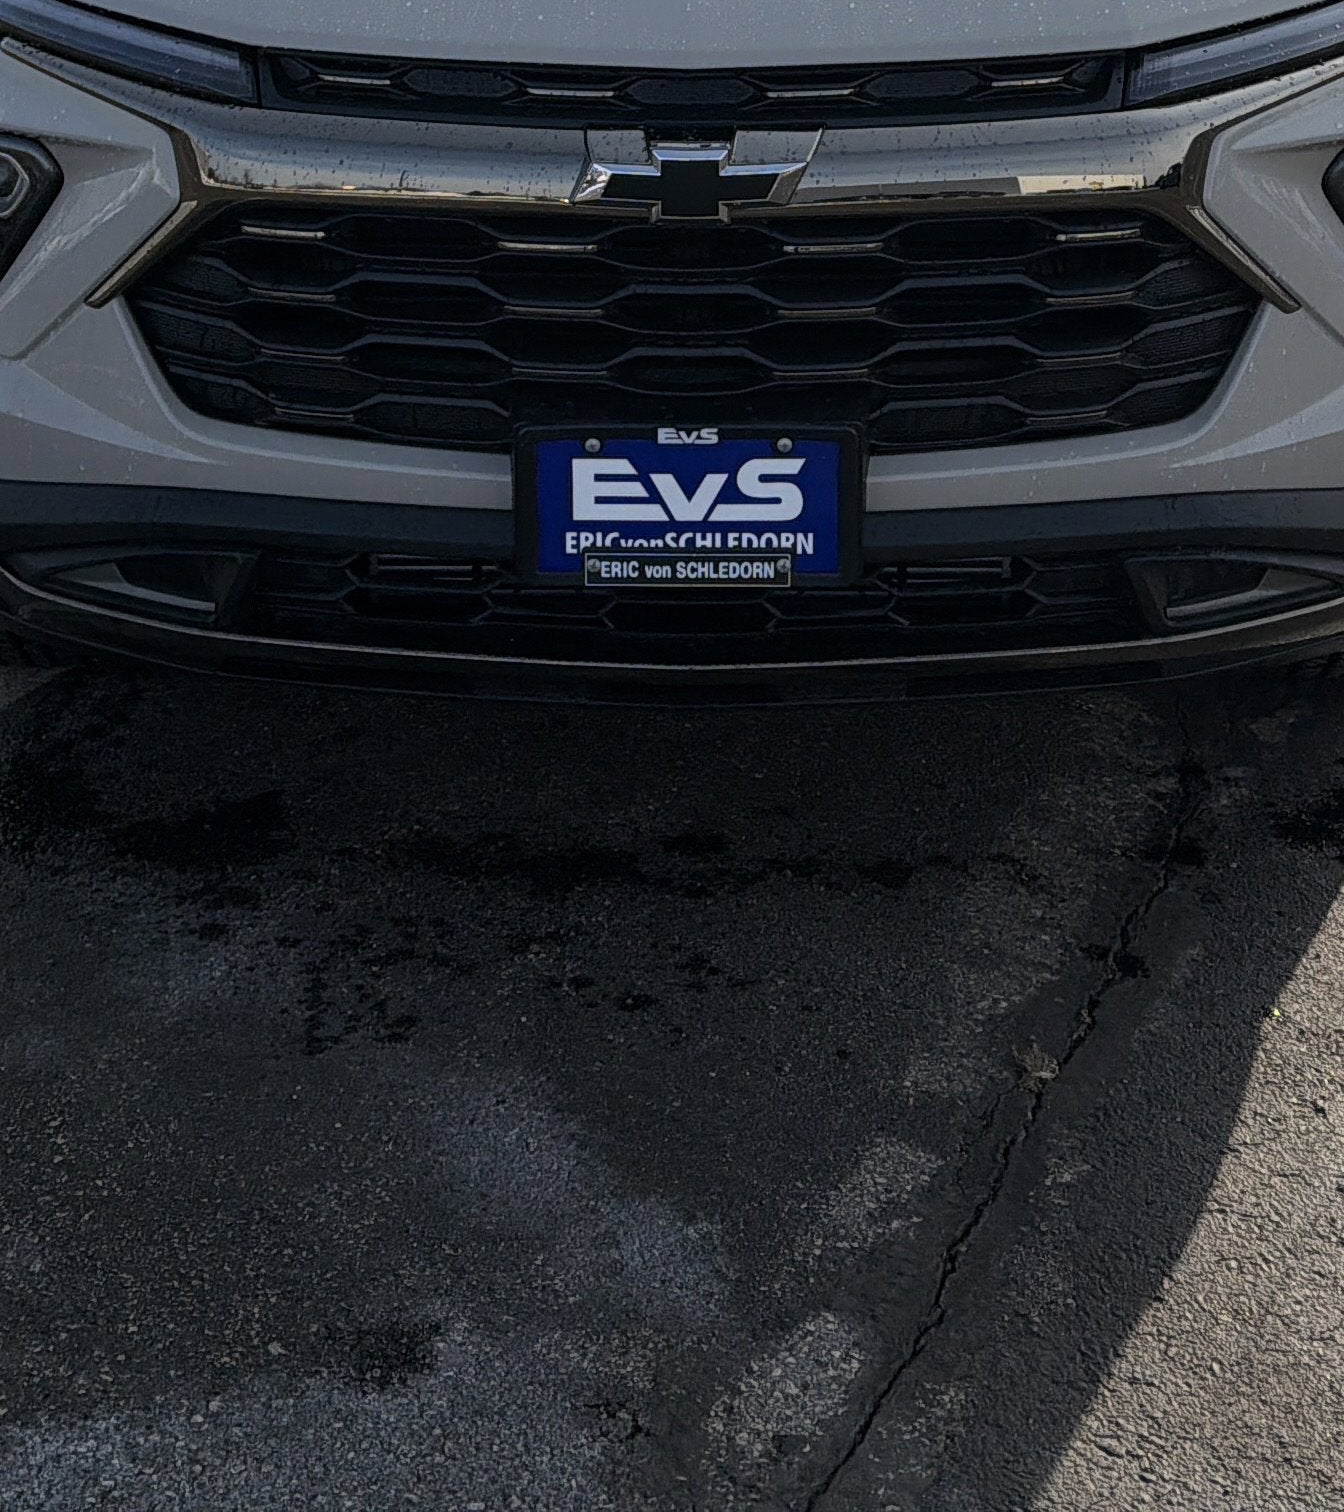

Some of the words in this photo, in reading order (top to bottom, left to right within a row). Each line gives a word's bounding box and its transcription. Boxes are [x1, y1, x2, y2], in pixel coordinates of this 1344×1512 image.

[600, 561, 640, 579] ERIC
[644, 565, 672, 579] von
[676, 561, 775, 579] SCHLEDORN
